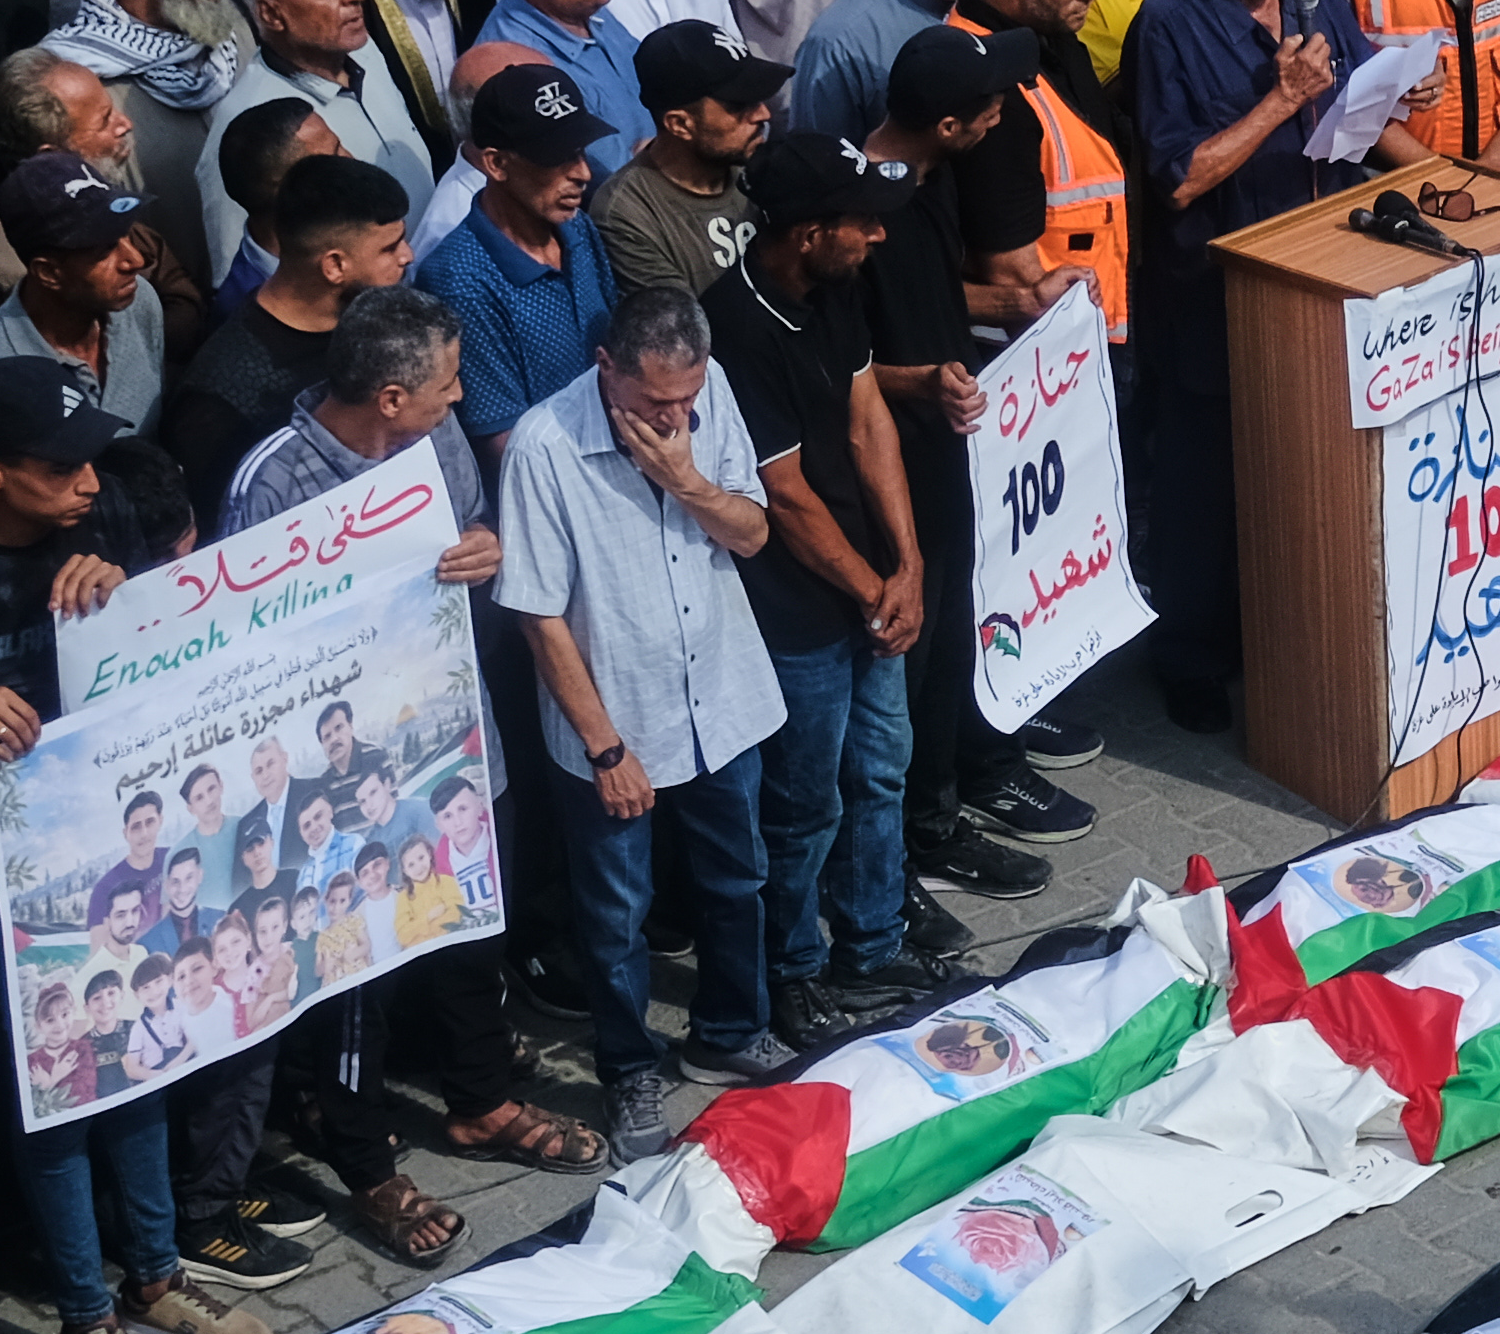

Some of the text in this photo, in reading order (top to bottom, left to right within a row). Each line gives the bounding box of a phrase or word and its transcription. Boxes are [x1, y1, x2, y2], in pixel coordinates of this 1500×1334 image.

[1438, 335, 1461, 373] is
[1449, 291, 1476, 322] is
[998, 346, 1092, 444] جنازة
[1002, 439, 1065, 556] 100
[1020, 514, 1112, 628] شهيد
[115, 658, 362, 803] شهداء مجزرة عائلة إرحيم
